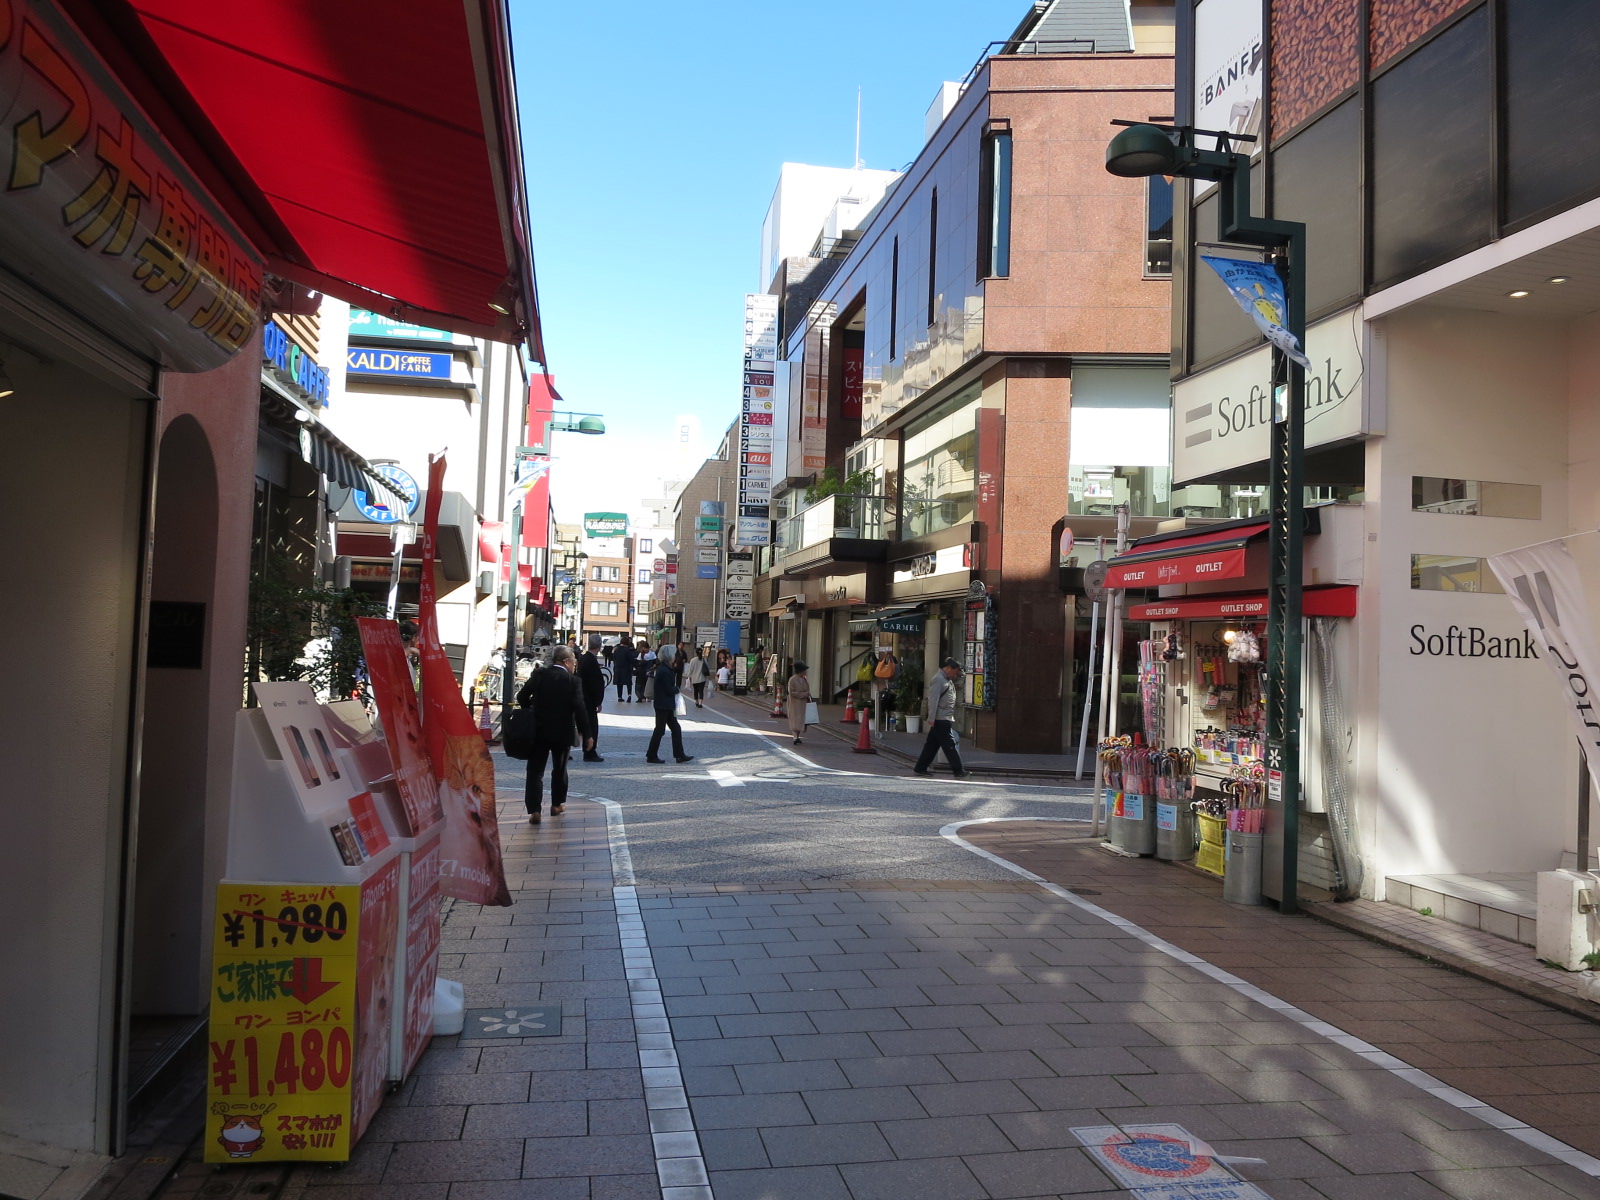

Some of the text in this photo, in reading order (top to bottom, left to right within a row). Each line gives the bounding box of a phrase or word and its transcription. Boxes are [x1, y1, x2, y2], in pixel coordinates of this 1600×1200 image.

[1205, 42, 1260, 106] BANFF
[0, 0, 263, 357] マホ専門店
[346, 351, 400, 371] KALDI
[401, 355, 432, 365] COFFEE
[401, 363, 432, 373] FARM
[1217, 357, 1345, 438] Softnk
[750, 454, 768, 463] au
[747, 481, 768, 489] CARMEL
[1123, 571, 1146, 581] OUTLET
[1196, 561, 1223, 573] OUTLET
[1146, 607, 1179, 616] OUTLET SHOP
[1221, 603, 1263, 613] OUTLET SHOP
[883, 622, 920, 632] CARMEL
[1409, 624, 1540, 659] SoftBank
[239, 886, 336, 906] ワン キュッパ
[222, 901, 348, 949] ¥1,980
[235, 1007, 341, 1030] ワン ヨンパ
[209, 1026, 351, 1099] ¥1,480
[277, 1113, 343, 1132] スマホが
